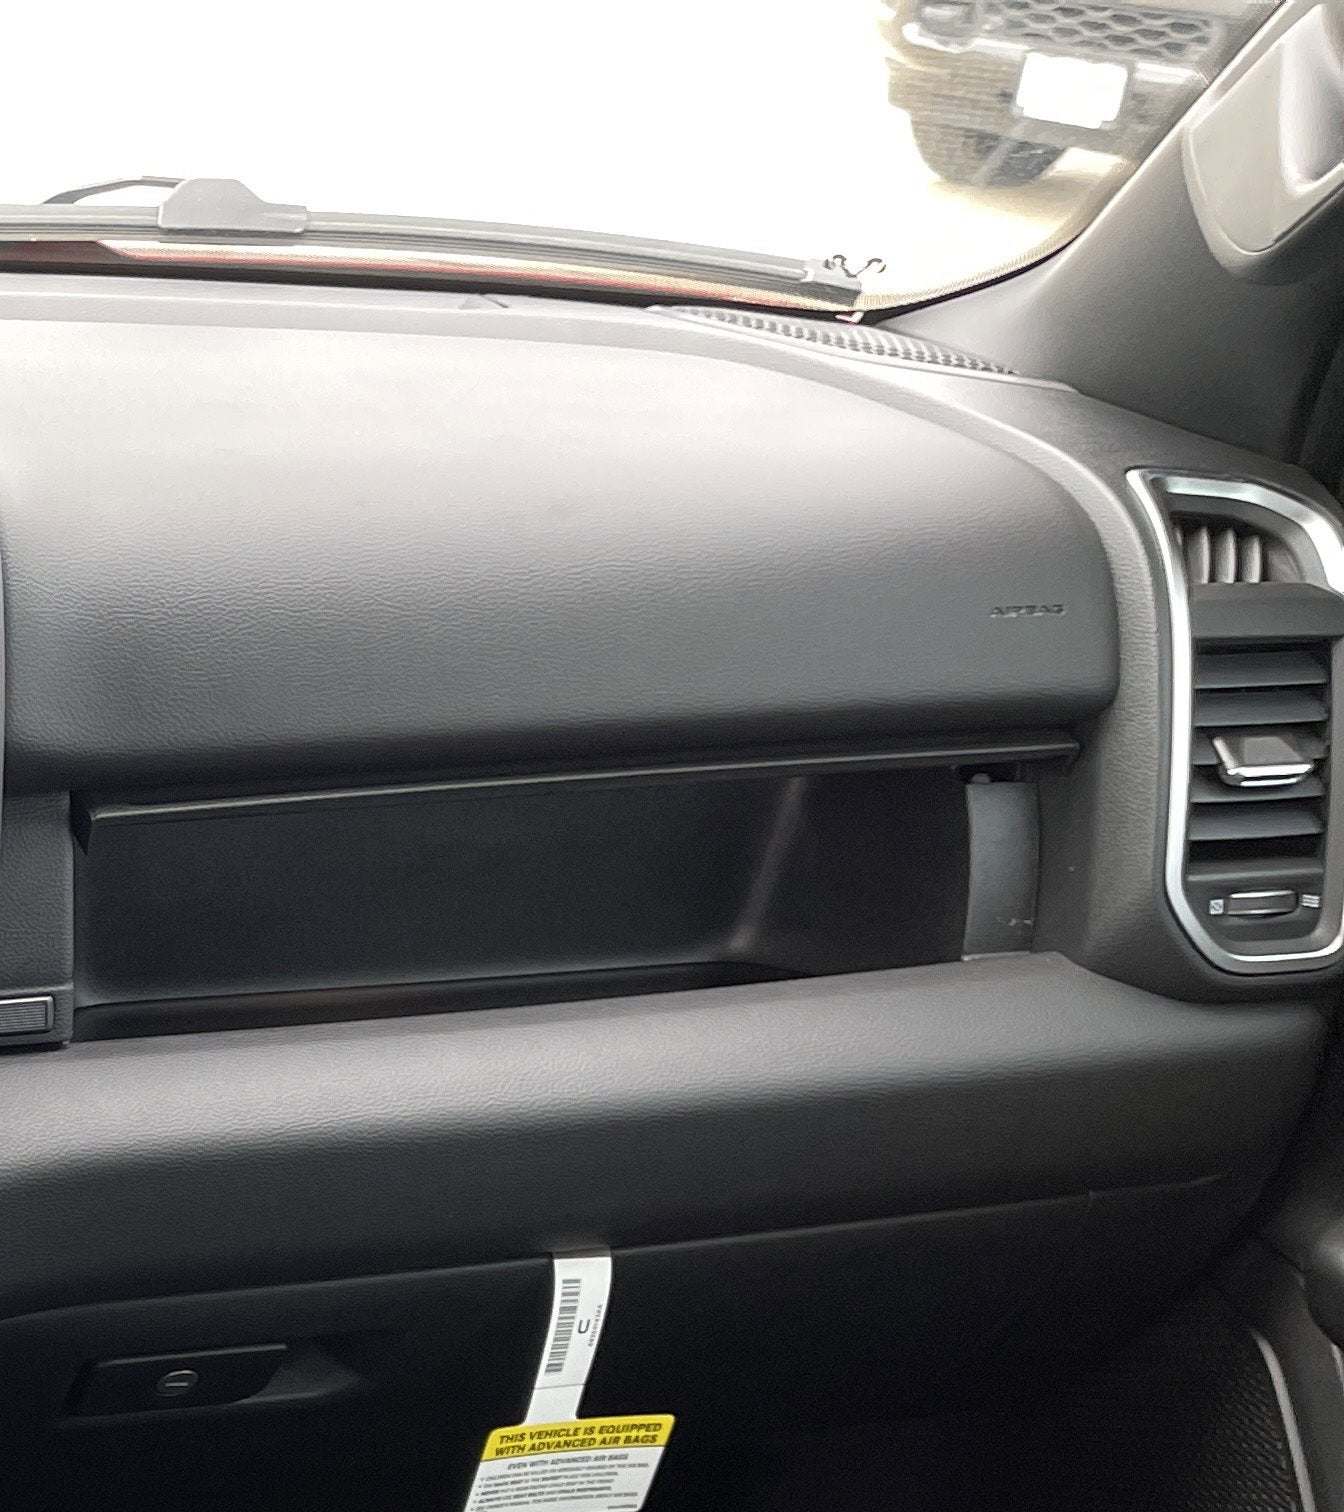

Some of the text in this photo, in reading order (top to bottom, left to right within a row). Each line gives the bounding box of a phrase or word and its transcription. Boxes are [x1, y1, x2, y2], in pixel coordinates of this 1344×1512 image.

[499, 1422, 662, 1445] THIS VEHICLE IS EQUIPPED
[495, 1434, 658, 1456] WITH ADVANCED AIR BAGS
